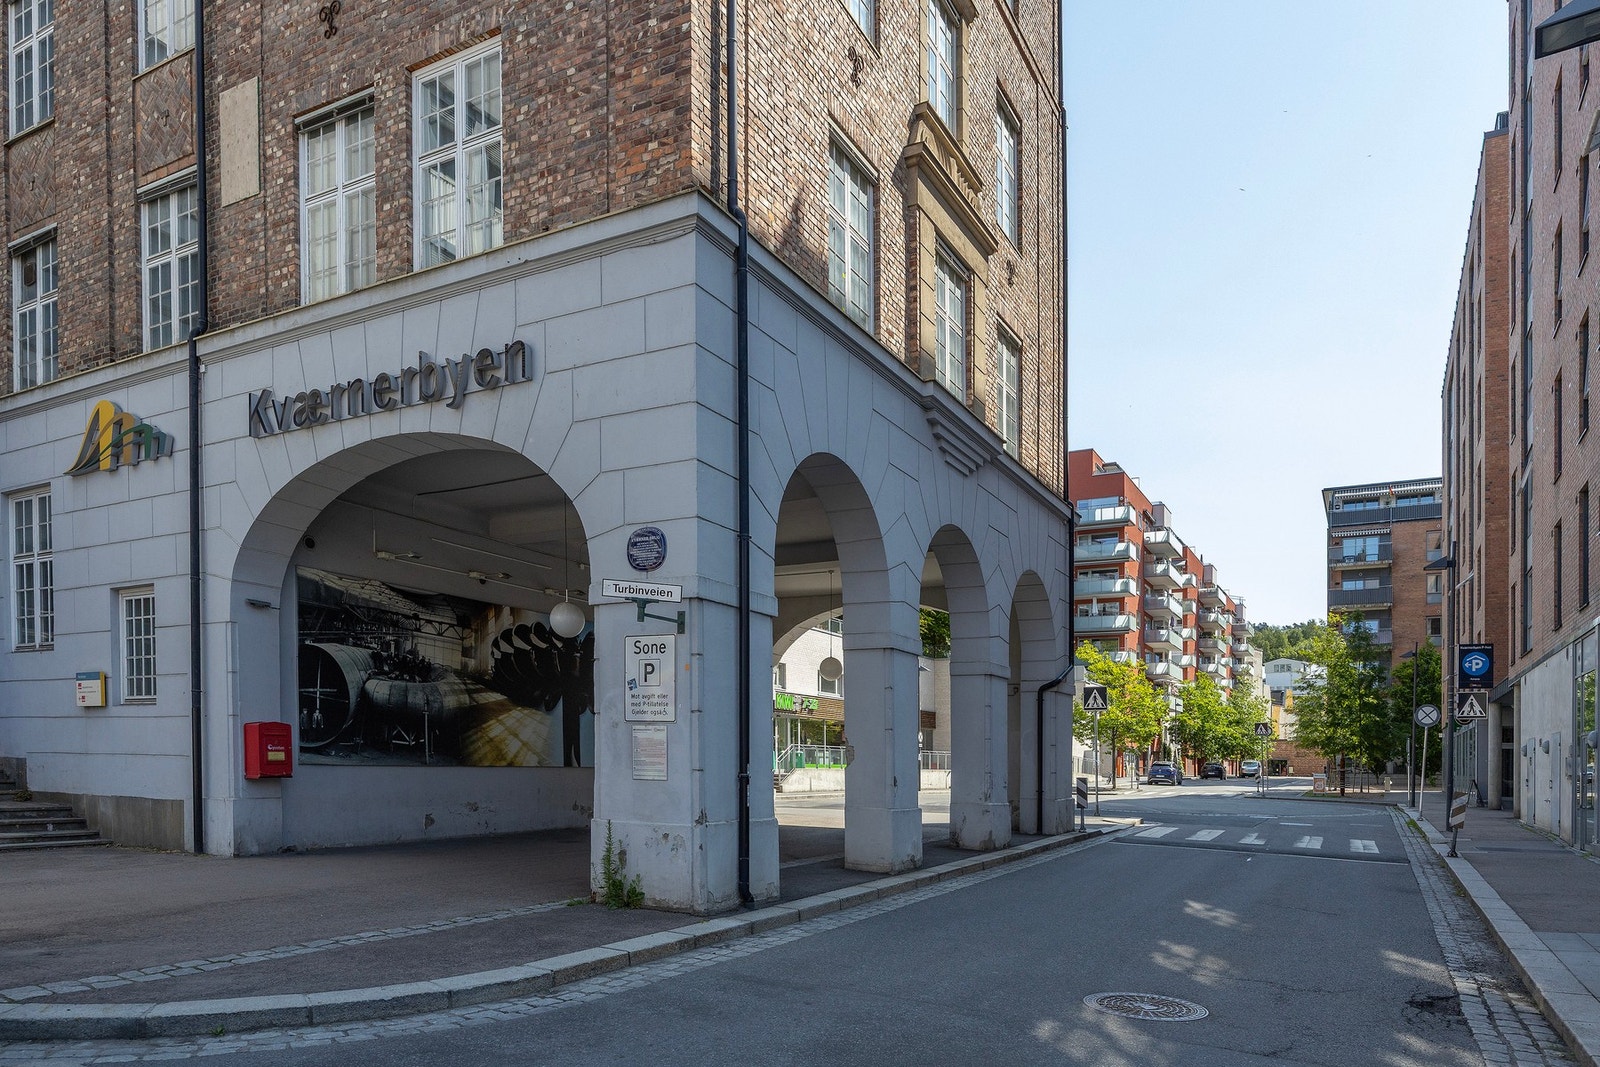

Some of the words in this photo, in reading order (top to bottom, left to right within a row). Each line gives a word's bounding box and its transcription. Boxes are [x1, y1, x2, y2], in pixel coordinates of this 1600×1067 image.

[249, 340, 532, 438] Kværnerbyen
[613, 583, 673, 597] Turbinveien
[634, 640, 666, 654] Sone
[644, 663, 655, 682] P
[1472, 660, 1483, 671] P
[641, 693, 656, 701] avgift
